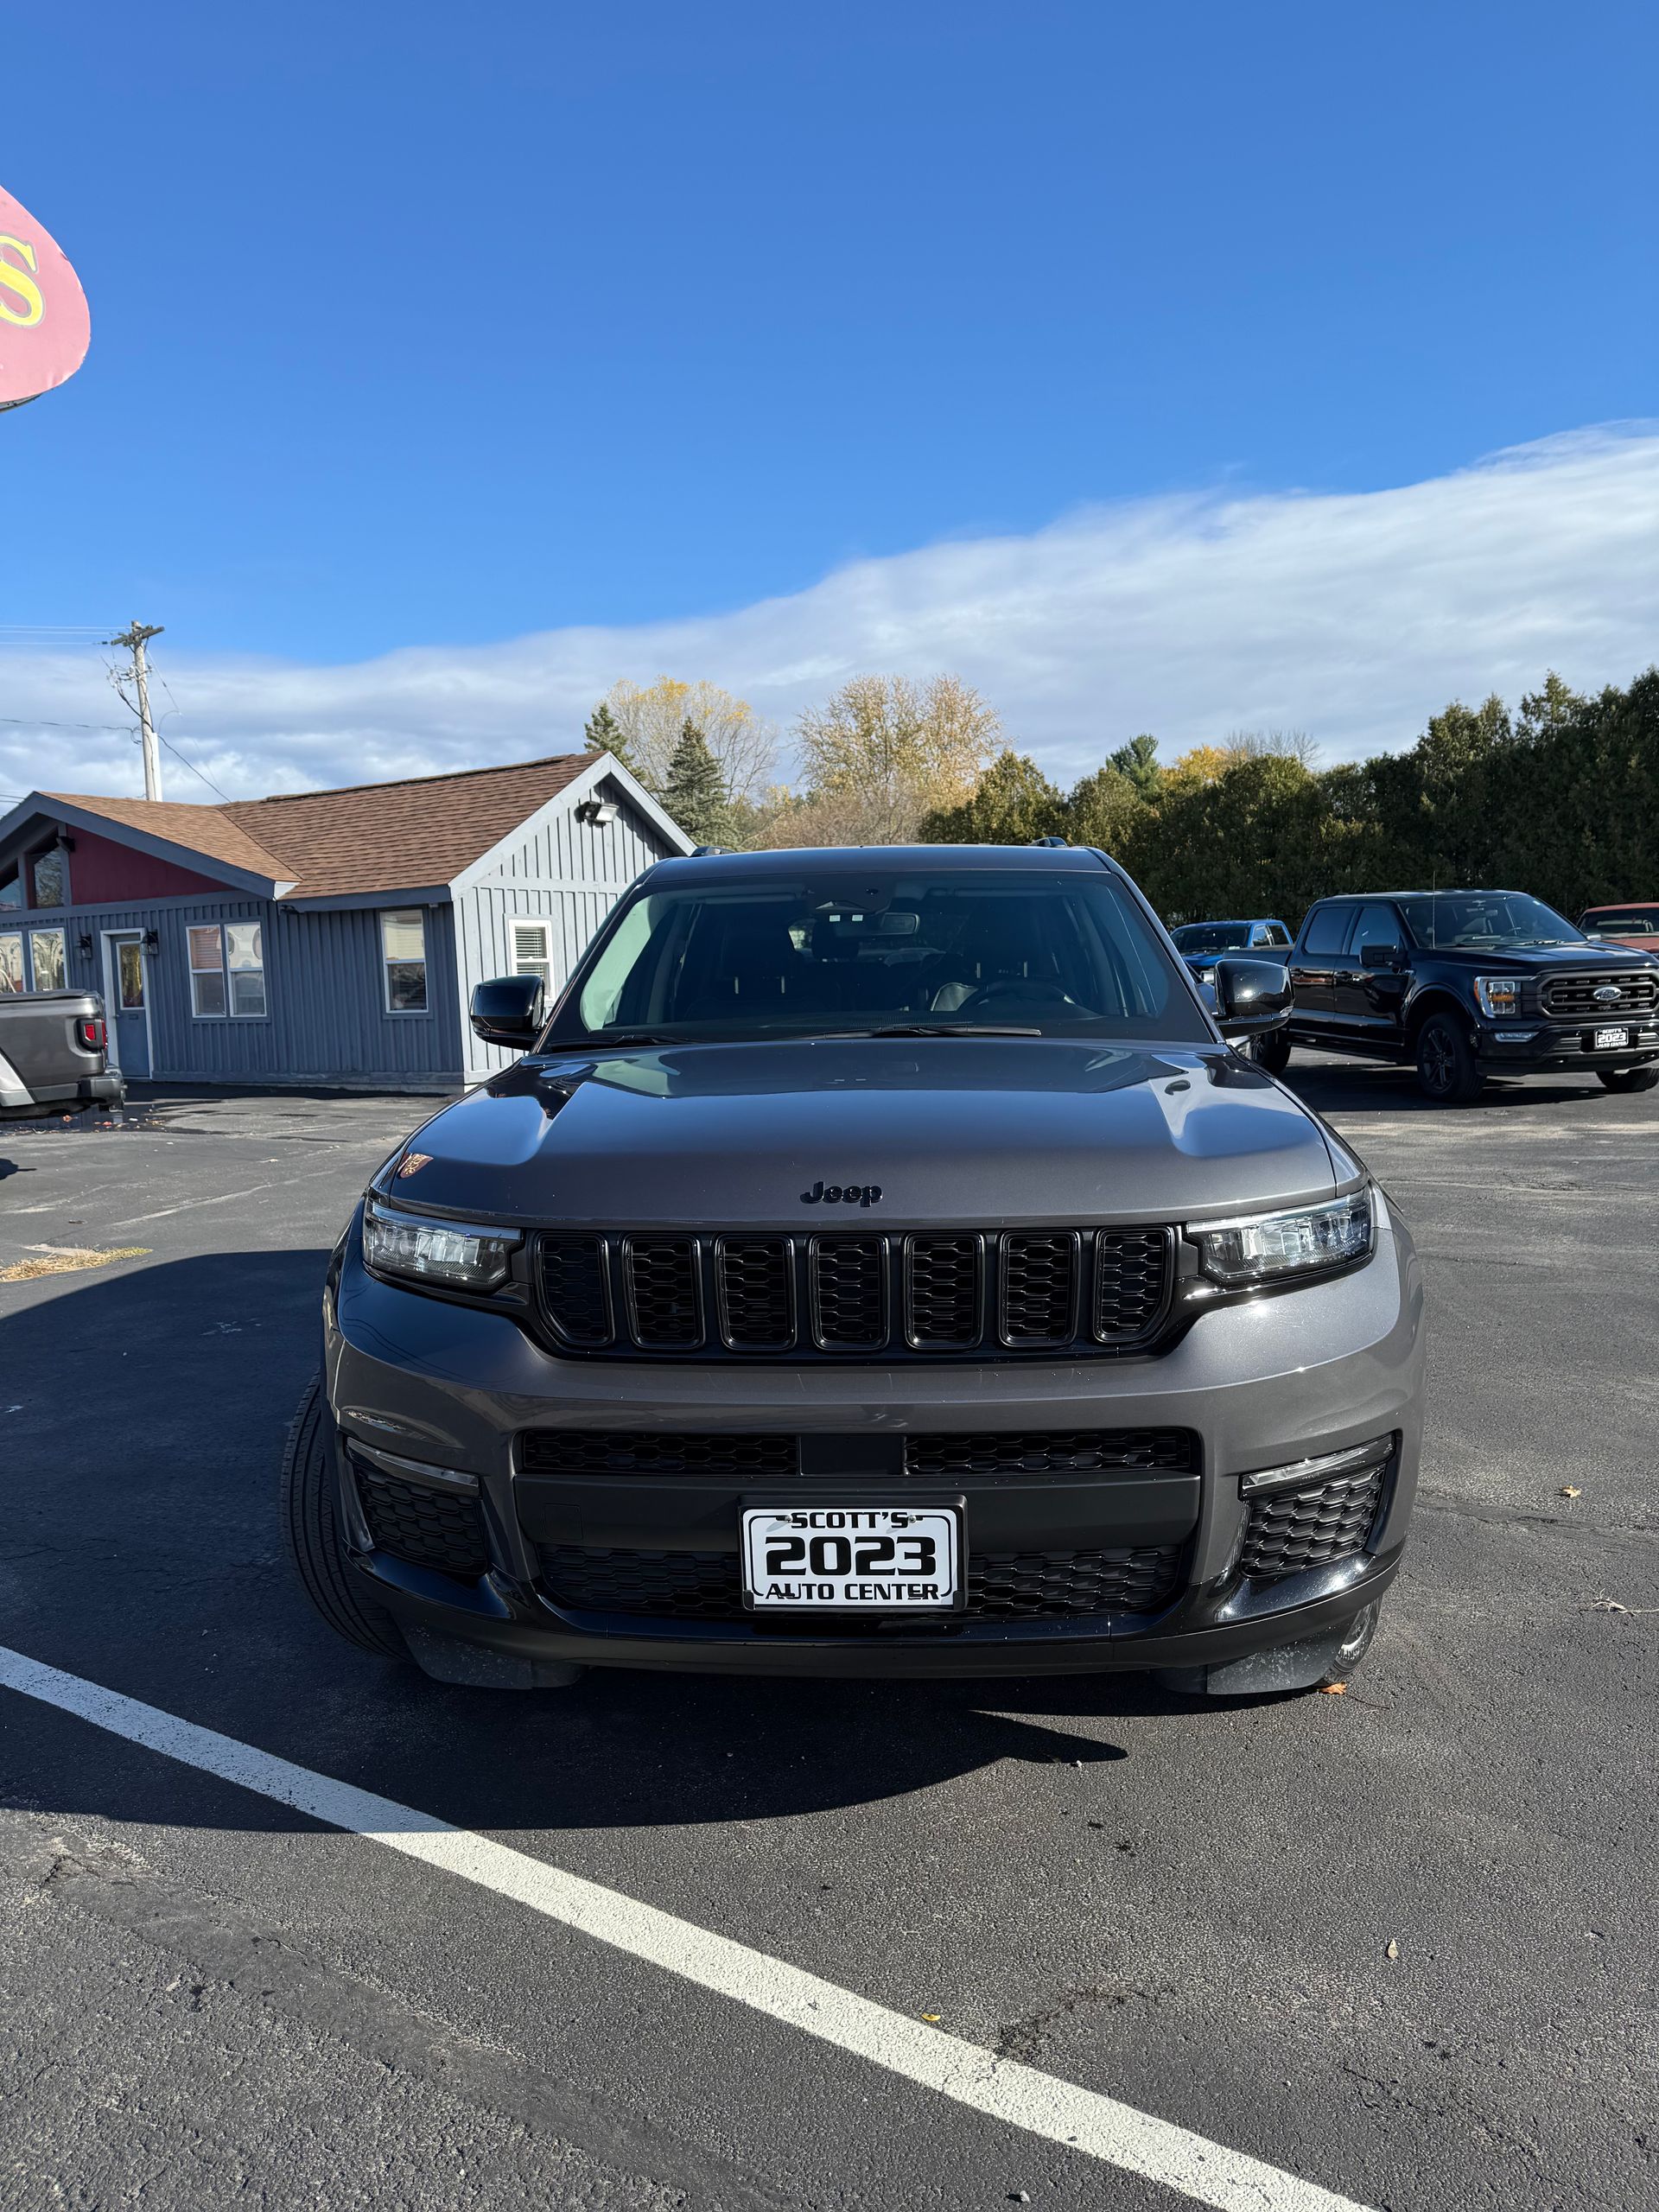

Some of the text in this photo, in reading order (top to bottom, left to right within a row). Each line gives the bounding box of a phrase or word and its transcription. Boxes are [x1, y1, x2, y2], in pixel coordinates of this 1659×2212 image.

[1598, 1033, 1626, 1043] 2023
[800, 1181, 883, 1207] Jeep
[791, 1512, 908, 1529] SCOTT'S
[765, 1536, 936, 1576] 2023
[765, 1583, 939, 1600] AUTO CENTER
